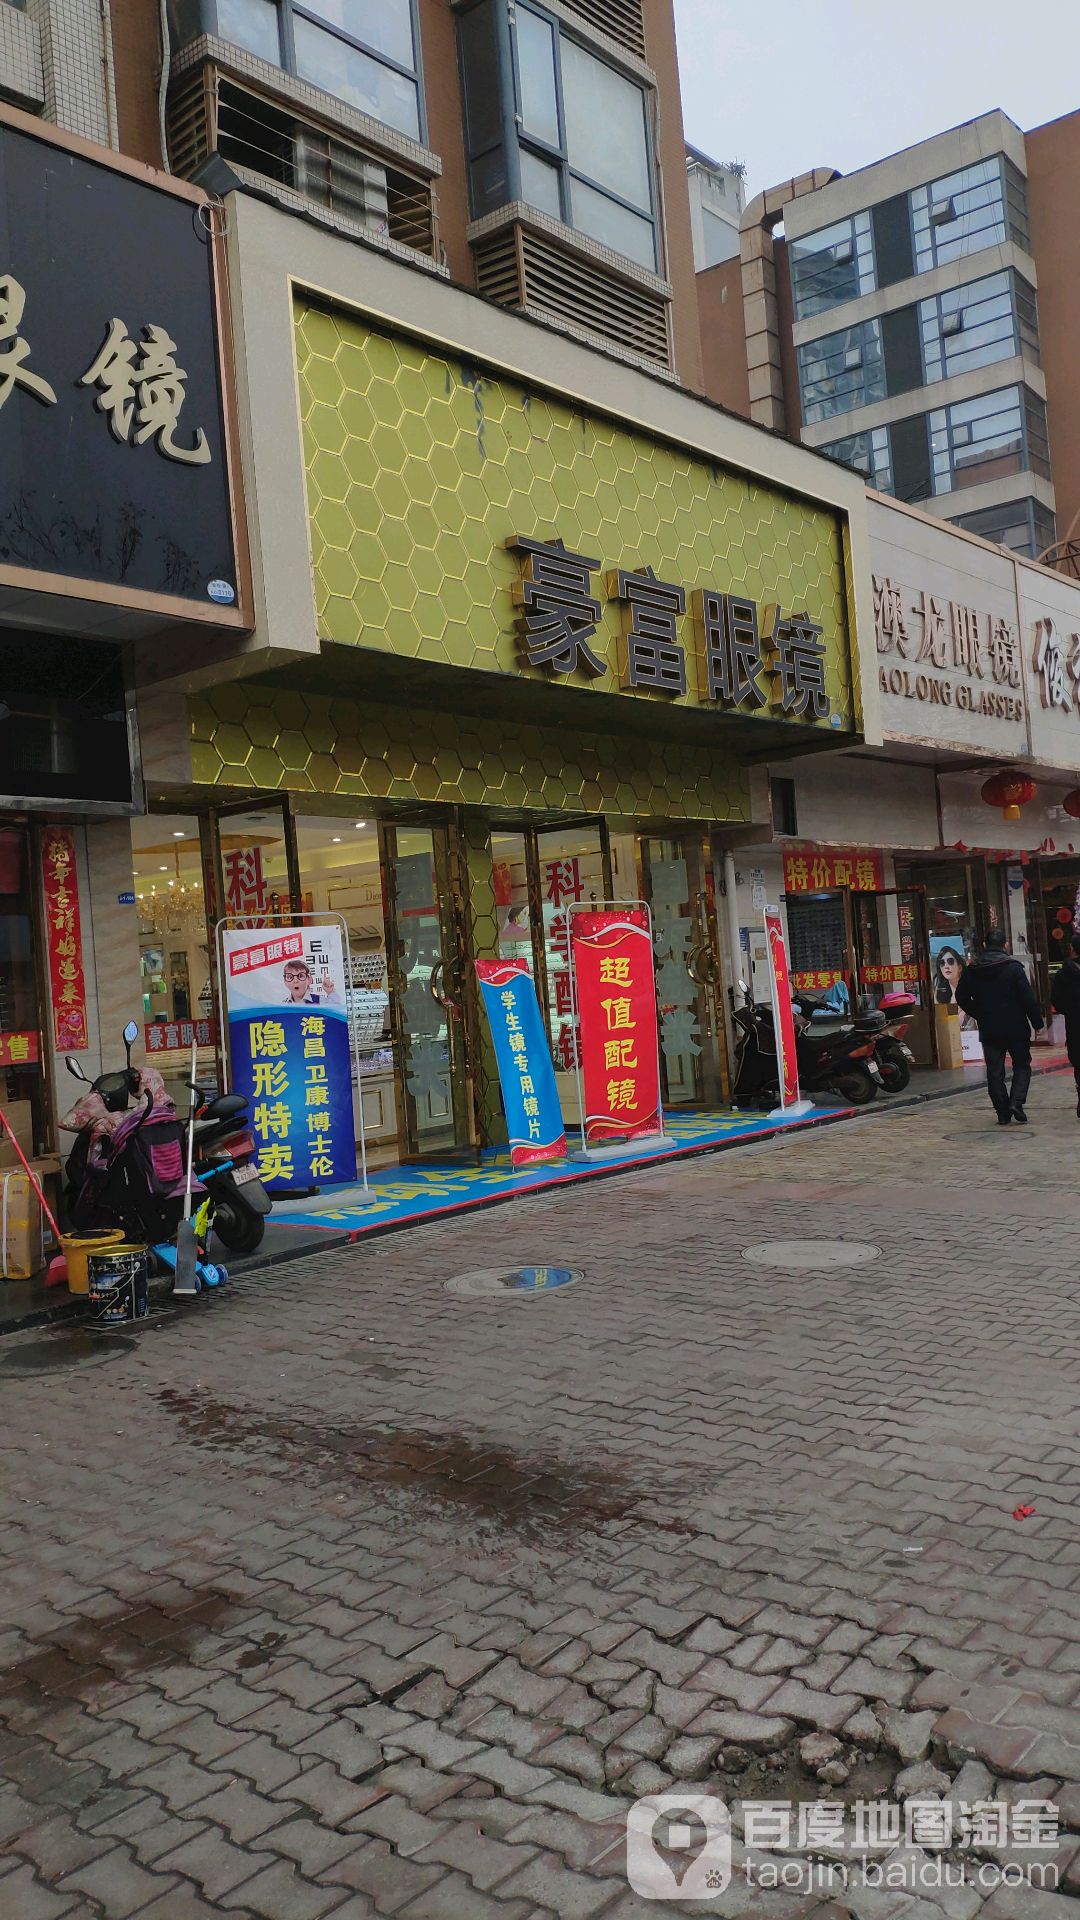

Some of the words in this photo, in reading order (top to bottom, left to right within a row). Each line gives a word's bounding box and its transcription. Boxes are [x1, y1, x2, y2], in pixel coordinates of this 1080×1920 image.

[505, 535, 831, 719] 豪富眼镜
[879, 665, 952, 706] AOLONG
[955, 684, 1023, 722] GLASSES
[224, 846, 268, 929] 科
[786, 857, 877, 891] 特价配镜
[232, 937, 301, 971] 豪富眼镜
[0, 1034, 29, 1062] 售
[148, 1021, 211, 1050] 豪富眼镜
[500, 990, 541, 1140] 学生镜专用镜片
[599, 955, 639, 1112] 超值配镜
[249, 1021, 294, 1183] 隐形特卖
[300, 1016, 335, 1177] 海昌卫康博士伦
